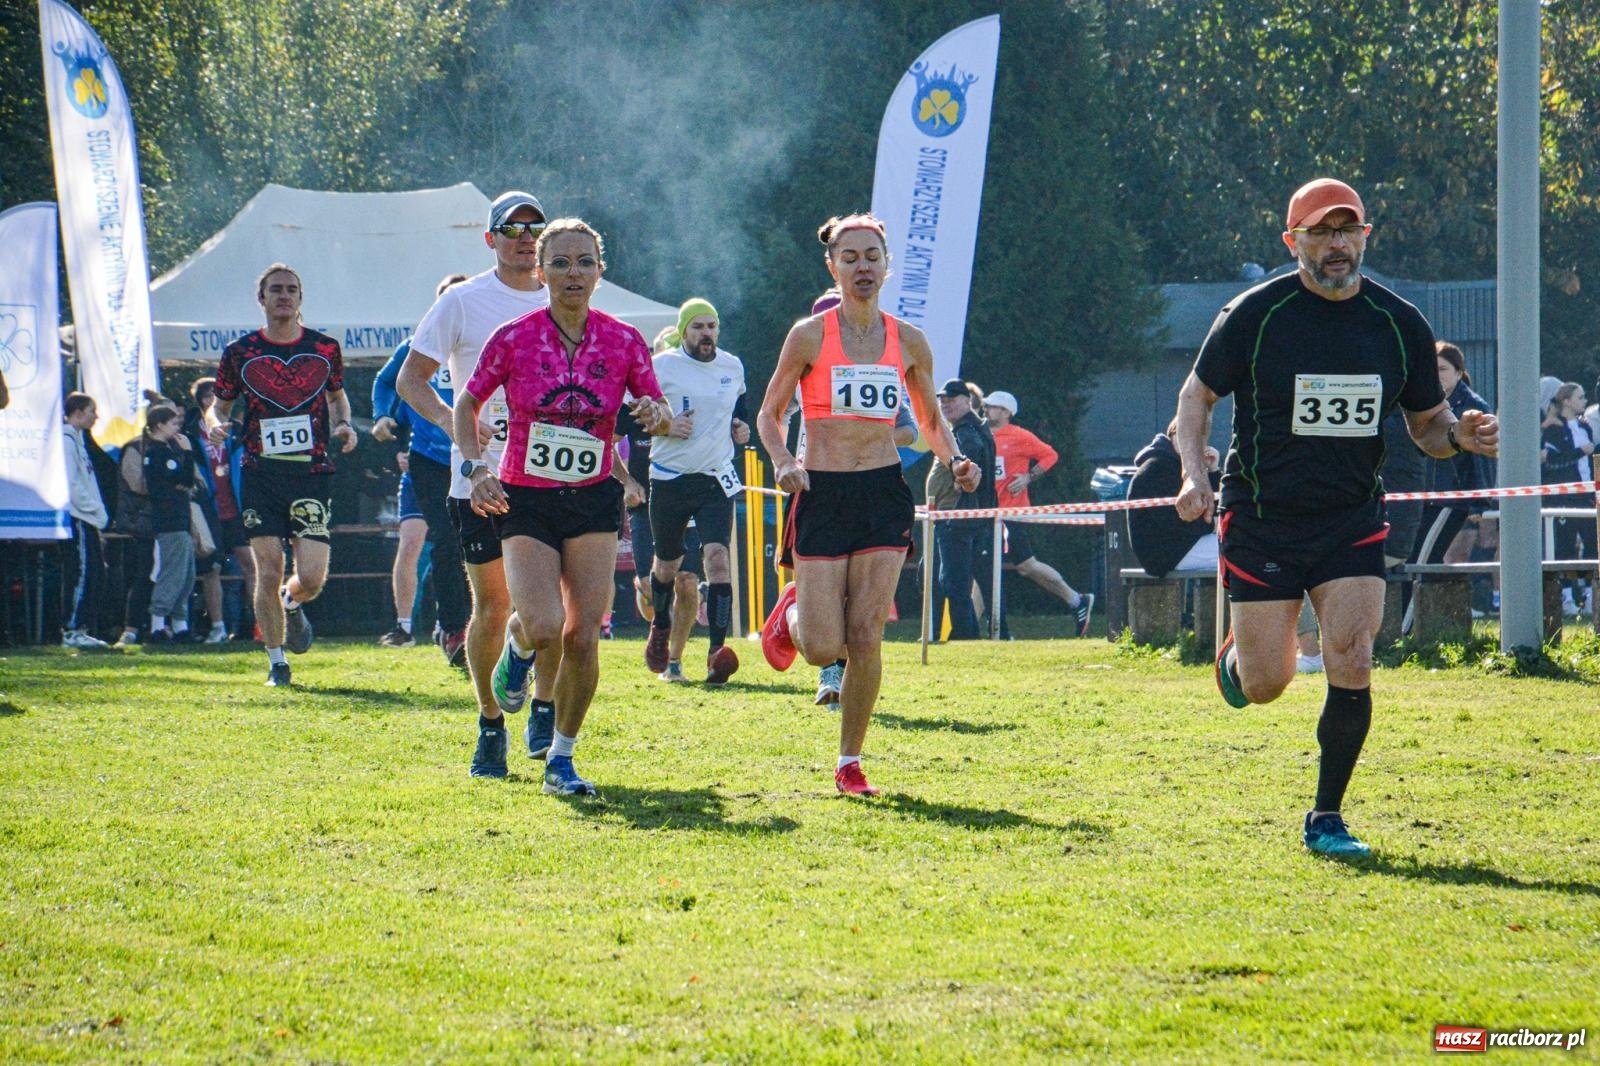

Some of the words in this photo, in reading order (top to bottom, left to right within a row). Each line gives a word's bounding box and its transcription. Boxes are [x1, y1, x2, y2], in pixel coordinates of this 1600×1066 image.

[86, 129, 122, 231] STOWARZYSZENIE
[908, 146, 948, 242] STOWARZYSZENIE
[901, 243, 934, 294] AKTYWNI
[898, 297, 927, 318] DLA
[838, 383, 898, 409] 196
[1299, 397, 1376, 425] 335
[266, 428, 309, 447] 150
[530, 443, 597, 474] 309
